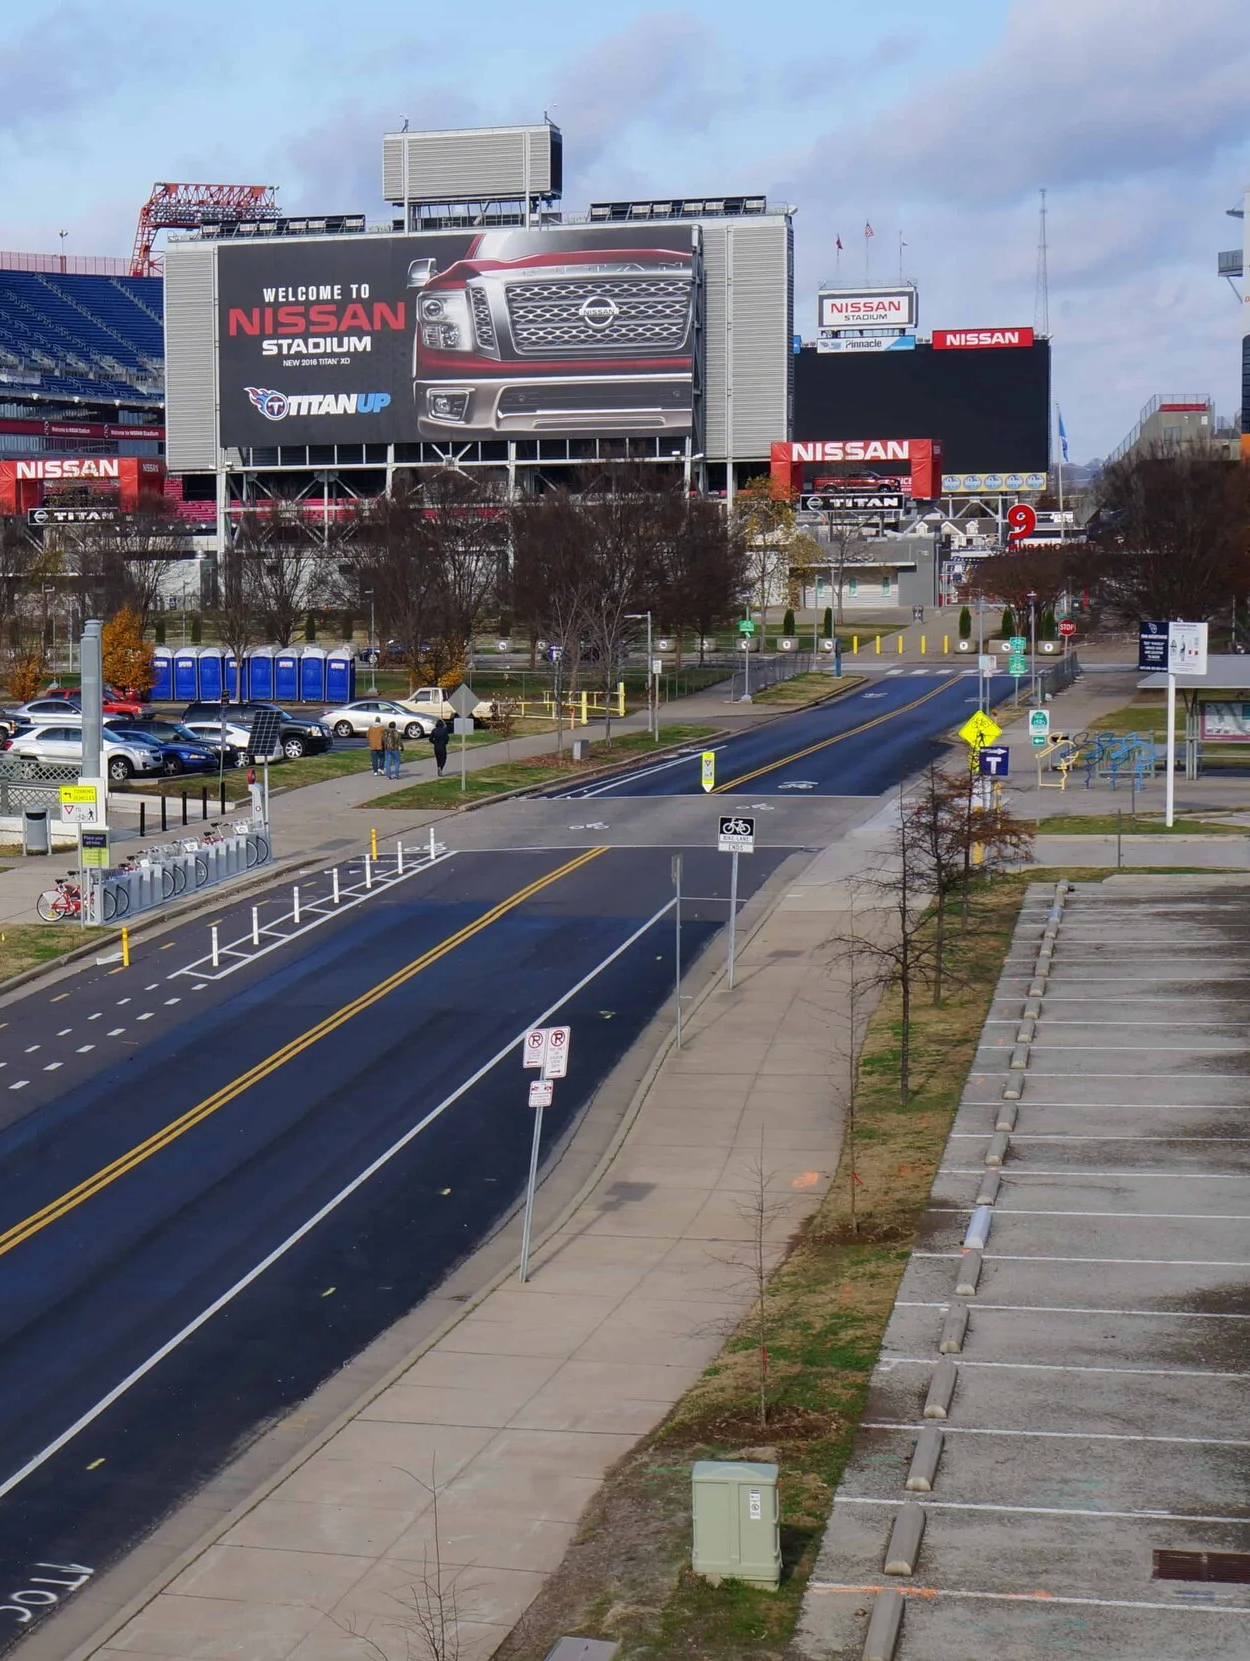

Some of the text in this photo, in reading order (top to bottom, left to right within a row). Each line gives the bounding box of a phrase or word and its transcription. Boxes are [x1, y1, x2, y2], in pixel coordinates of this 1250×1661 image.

[263, 283, 370, 303] WELCOME TO
[583, 308, 615, 316] NISSAN
[830, 301, 901, 313] NISSAN
[229, 301, 406, 336] NISSAN
[844, 313, 888, 321] STADIUM
[845, 339, 882, 350] Pinnacle
[946, 331, 1019, 346] NISSAN
[262, 336, 372, 356] STADIUM
[283, 359, 300, 367] NEW
[302, 358, 317, 366] 2016
[340, 357, 350, 365] XD
[792, 441, 909, 461] NISSAN
[16, 459, 119, 479] NISSAN
[829, 497, 899, 507] TITAN
[53, 511, 114, 522] TITAN
[1007, 504, 1037, 541] 9
[1059, 623, 1075, 631] STOP
[986, 757, 1002, 774] T
